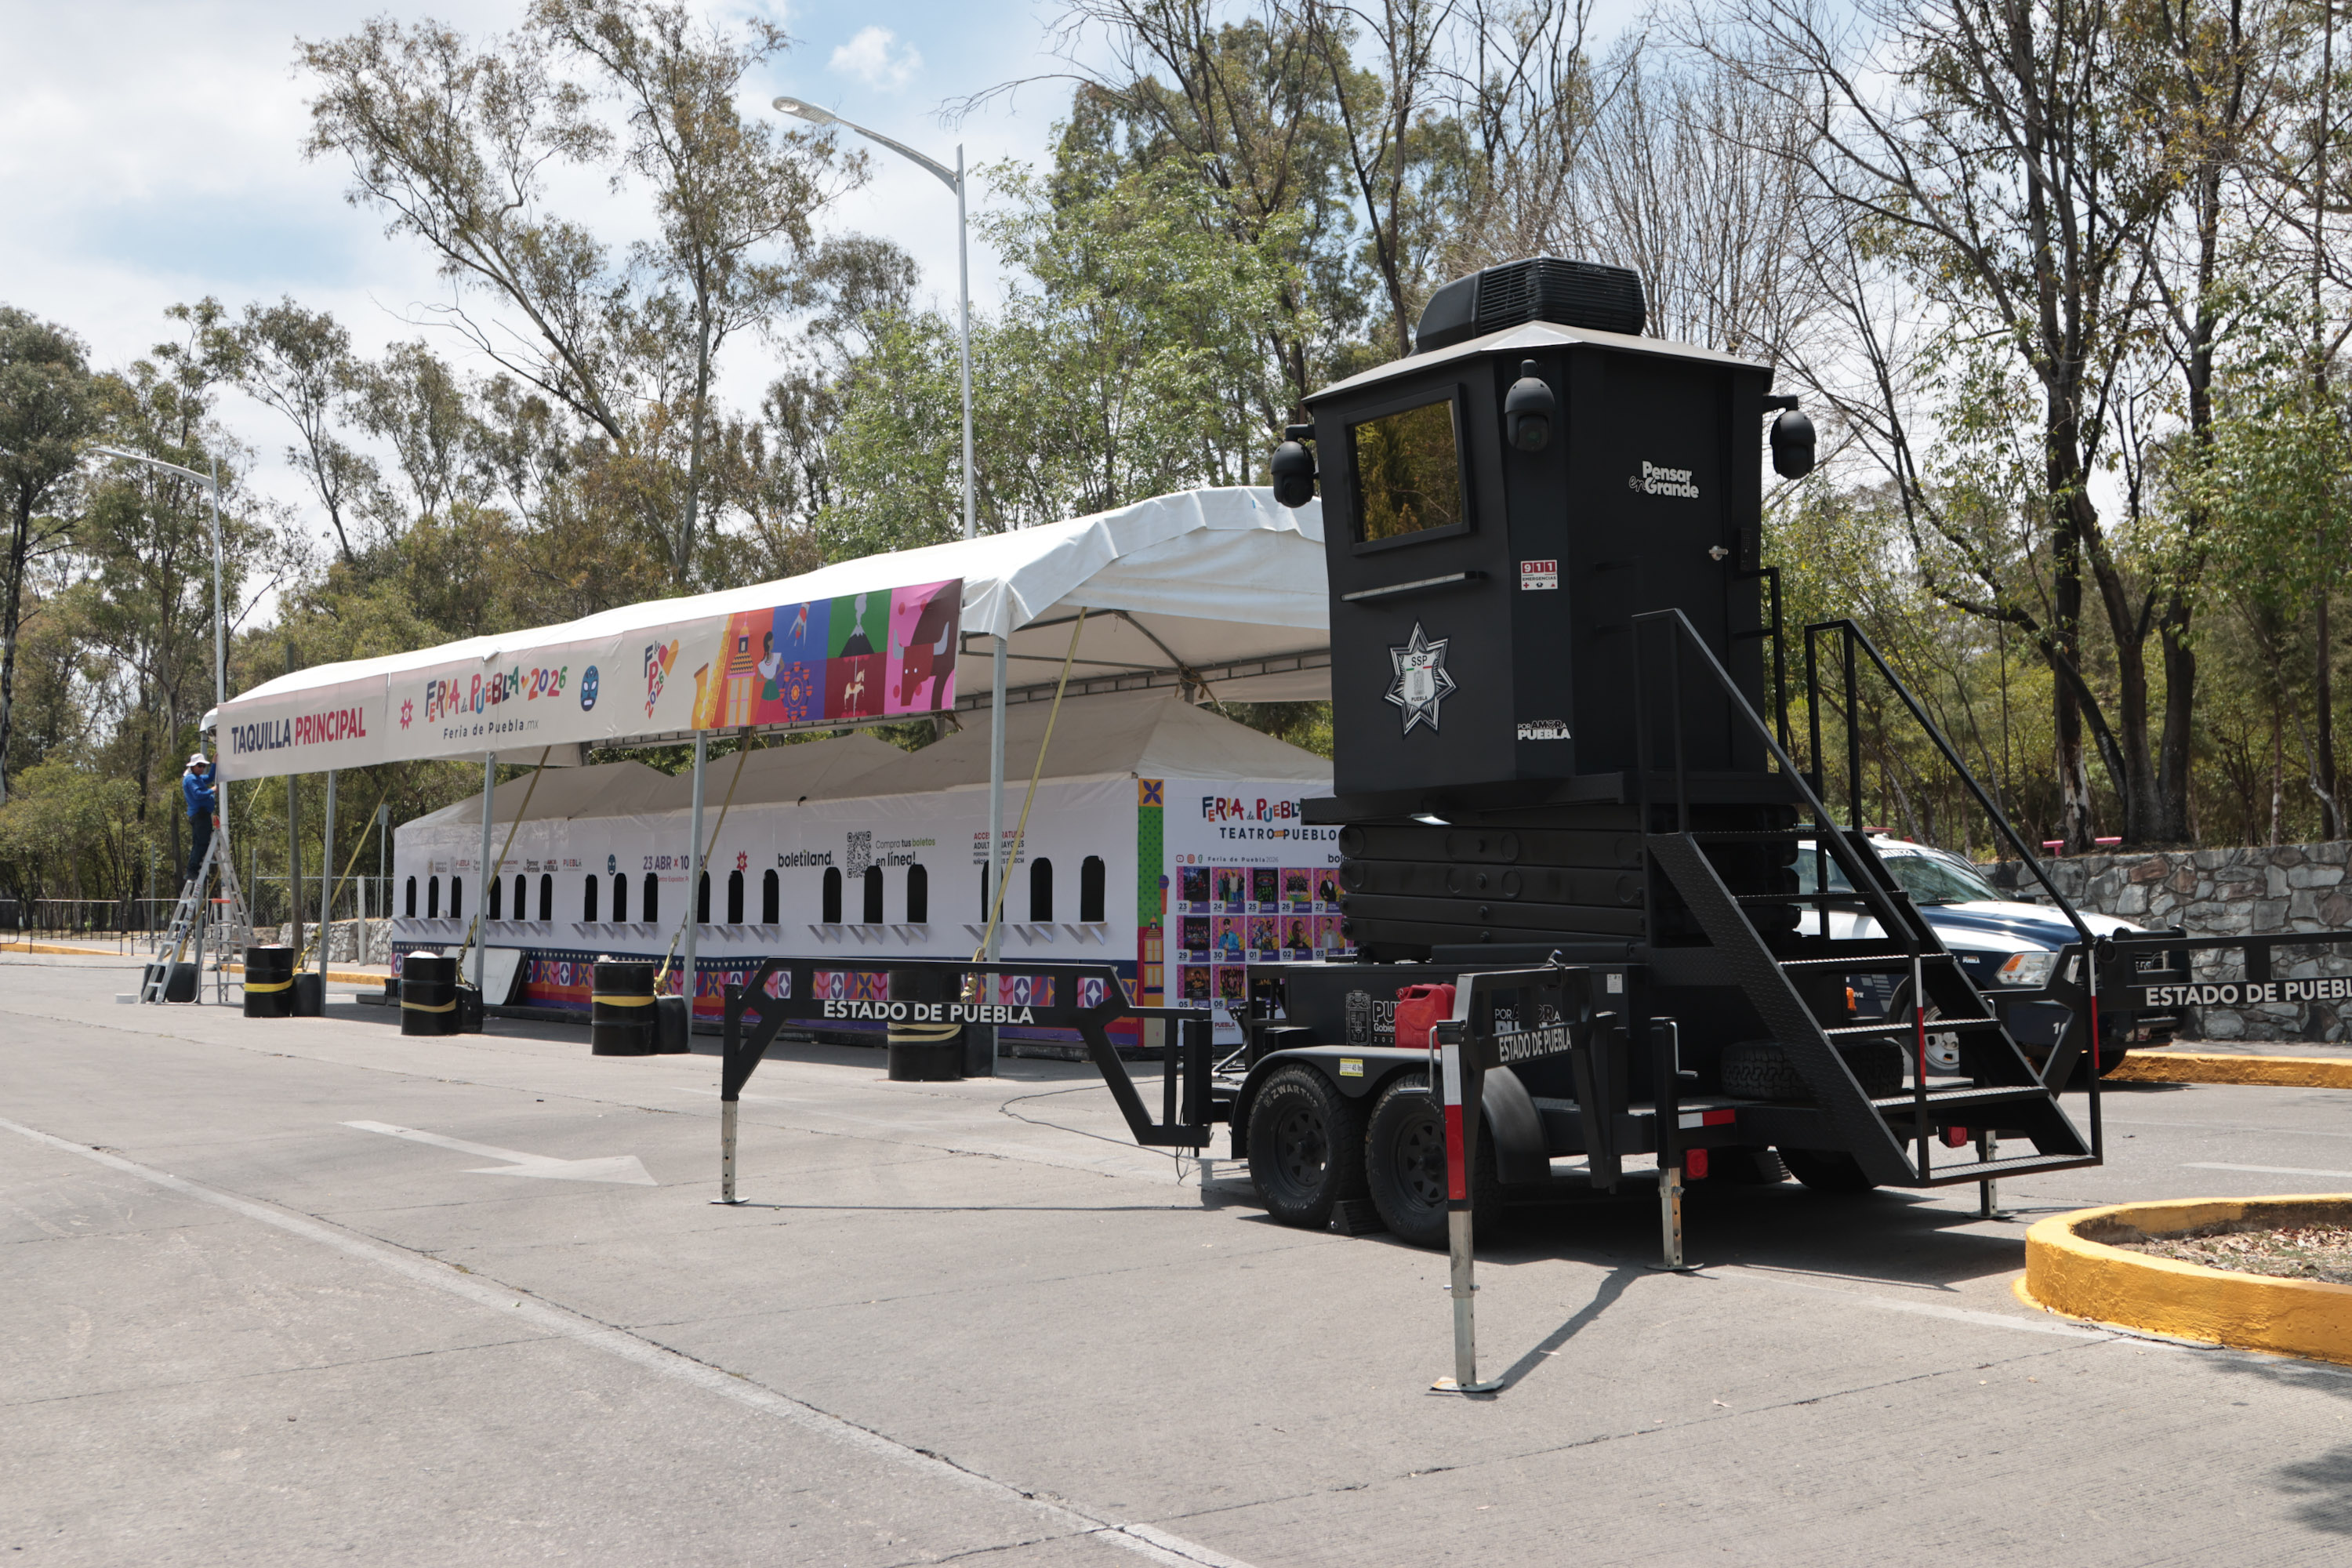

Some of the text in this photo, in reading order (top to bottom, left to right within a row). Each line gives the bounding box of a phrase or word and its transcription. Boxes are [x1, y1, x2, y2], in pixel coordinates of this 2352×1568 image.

[1642, 460, 1693, 482] Pensar
[1629, 475, 1700, 499] en Grande
[1523, 562, 1553, 572] 911
[1411, 655, 1428, 666] SSP
[425, 665, 568, 723] FERIA de PUEBLA 2026
[231, 706, 366, 754] TAQUILLA PRINCIPAL
[443, 725, 468, 740] Feria
[473, 723, 484, 736] de
[1530, 720, 1563, 730] AMOR
[1517, 728, 1572, 741] PUEBLA
[1202, 796, 1245, 822] FERIA
[1247, 811, 1255, 821] de
[1219, 827, 1275, 840] TEATRO
[1283, 829, 1338, 841] PUEBLO
[875, 838, 936, 850] Compra tus boletos
[643, 855, 653, 870] 23
[654, 855, 672, 870] ABR
[681, 855, 690, 870] 10
[778, 849, 832, 868] boletiland
[875, 851, 916, 867] en línea!
[2146, 984, 2239, 1007] ESTADO
[2246, 982, 2277, 1004] DE
[823, 1000, 1034, 1025] ESTADO DE PUEBLA
[1498, 1028, 1573, 1063] ESTADO DE PUEBLA
